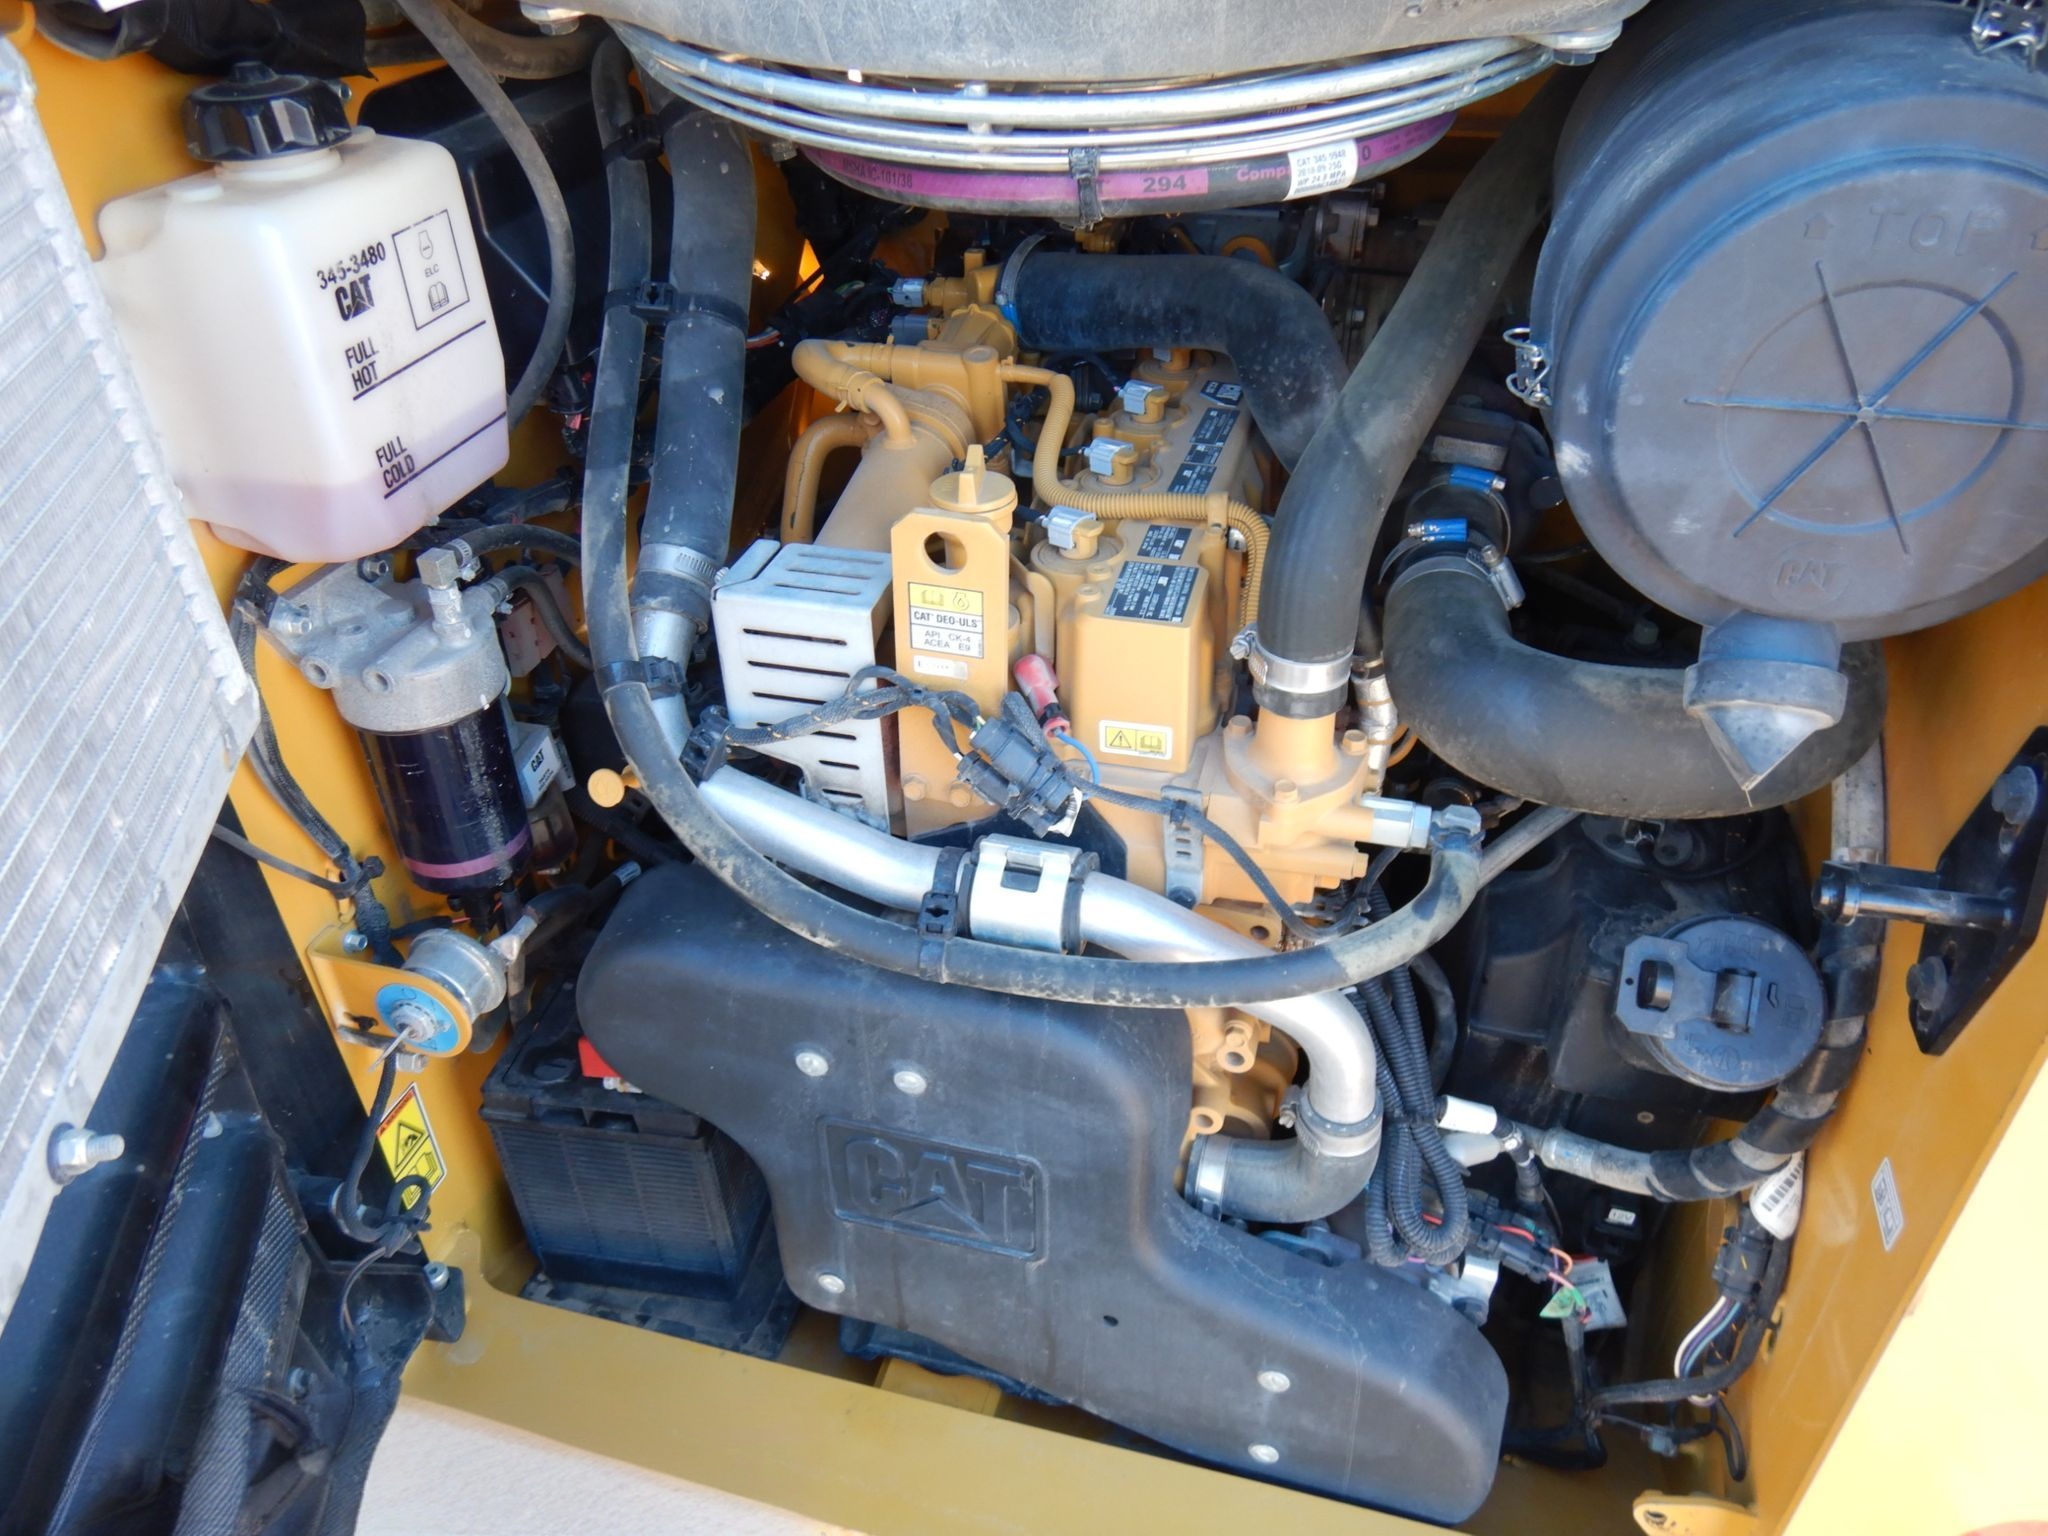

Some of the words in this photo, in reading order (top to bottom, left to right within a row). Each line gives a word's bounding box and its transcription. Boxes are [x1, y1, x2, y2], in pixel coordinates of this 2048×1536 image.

[1296, 158, 1310, 168] CAT
[1143, 174, 1187, 193] 294
[1868, 202, 2006, 257] TOP
[316, 241, 387, 290] 345-3480
[424, 263, 440, 278] ELC
[334, 273, 375, 322] CAT
[344, 336, 380, 369] FULL
[351, 360, 379, 392] HOT
[375, 435, 408, 468] FULL
[382, 453, 416, 489] COLD
[924, 630, 941, 639] API
[948, 633, 971, 643] CK-4
[924, 638, 951, 649] ACEA
[958, 643, 971, 652] E9
[843, 1135, 1024, 1245] CAT
